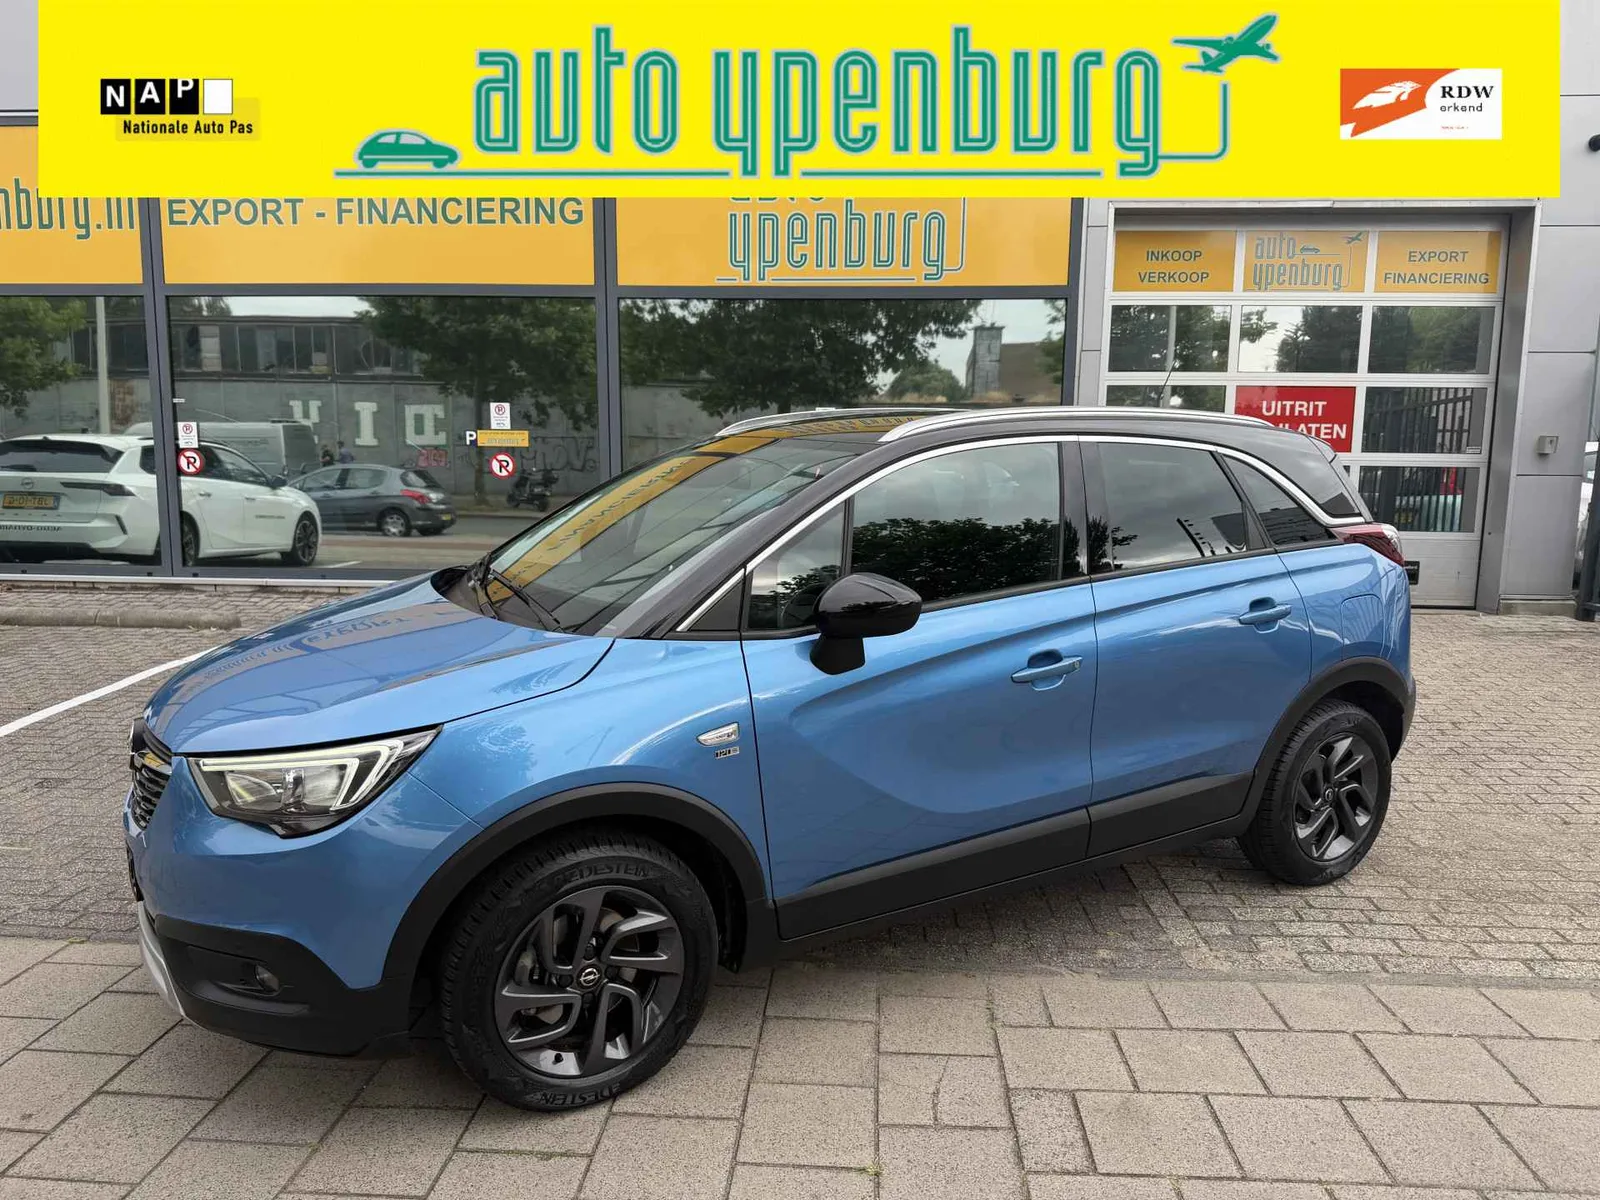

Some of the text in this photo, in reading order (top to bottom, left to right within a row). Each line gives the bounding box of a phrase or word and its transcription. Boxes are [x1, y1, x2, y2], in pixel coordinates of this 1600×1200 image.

[167, 198, 304, 226] EXPORT
[336, 197, 584, 225] FINANCIERING
[729, 198, 946, 282] ypenburg
[1255, 232, 1297, 260] auto
[1146, 249, 1202, 262] INKOOP
[1407, 250, 1469, 263] EXPORT
[1138, 271, 1210, 283] VERKOOP
[1253, 258, 1343, 291] ypenburg
[1383, 272, 1490, 285] FINANCIERING
[1262, 400, 1327, 417] UITRIT
